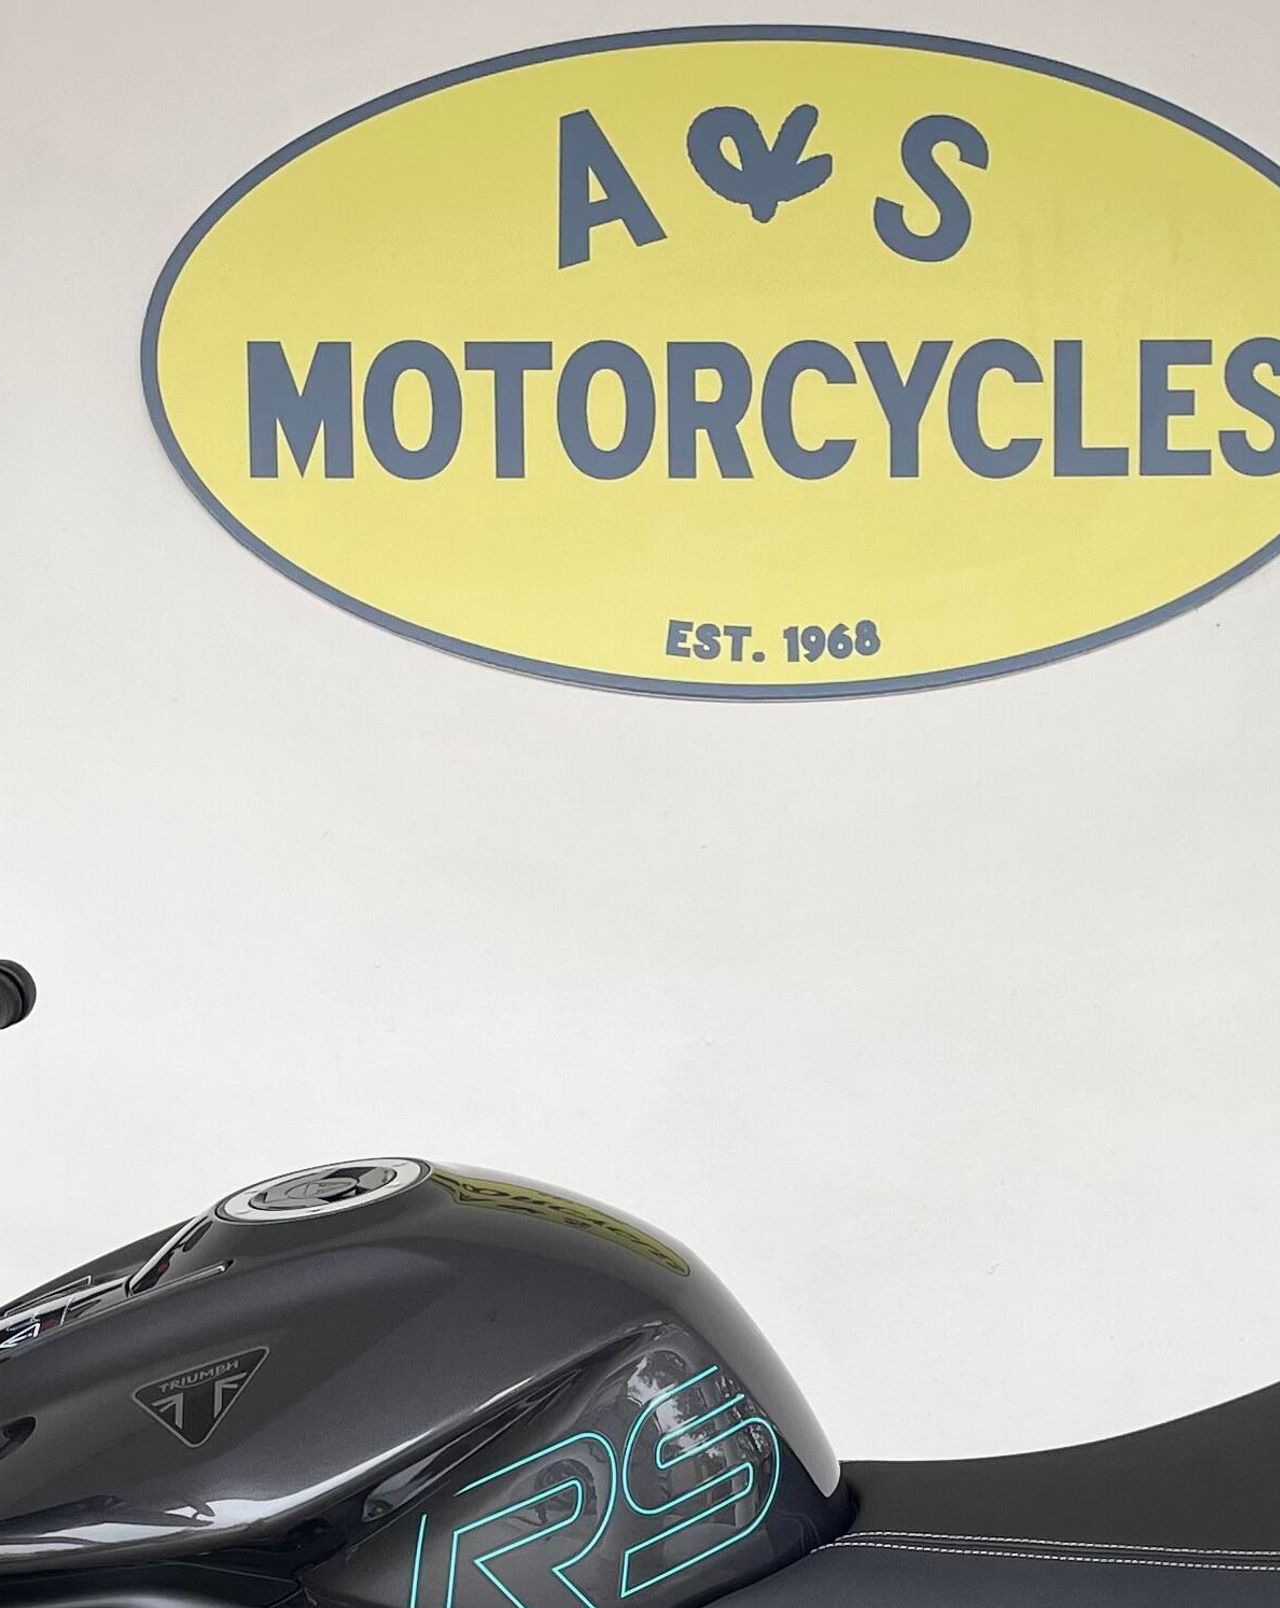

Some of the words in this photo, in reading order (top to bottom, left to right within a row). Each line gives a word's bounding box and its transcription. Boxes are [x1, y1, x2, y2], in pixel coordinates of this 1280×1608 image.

[558, 108, 667, 269] A
[872, 114, 991, 263] S
[664, 618, 766, 664] EST.
[782, 620, 882, 664] 1968
[159, 1359, 240, 1393] TRIUMPH
